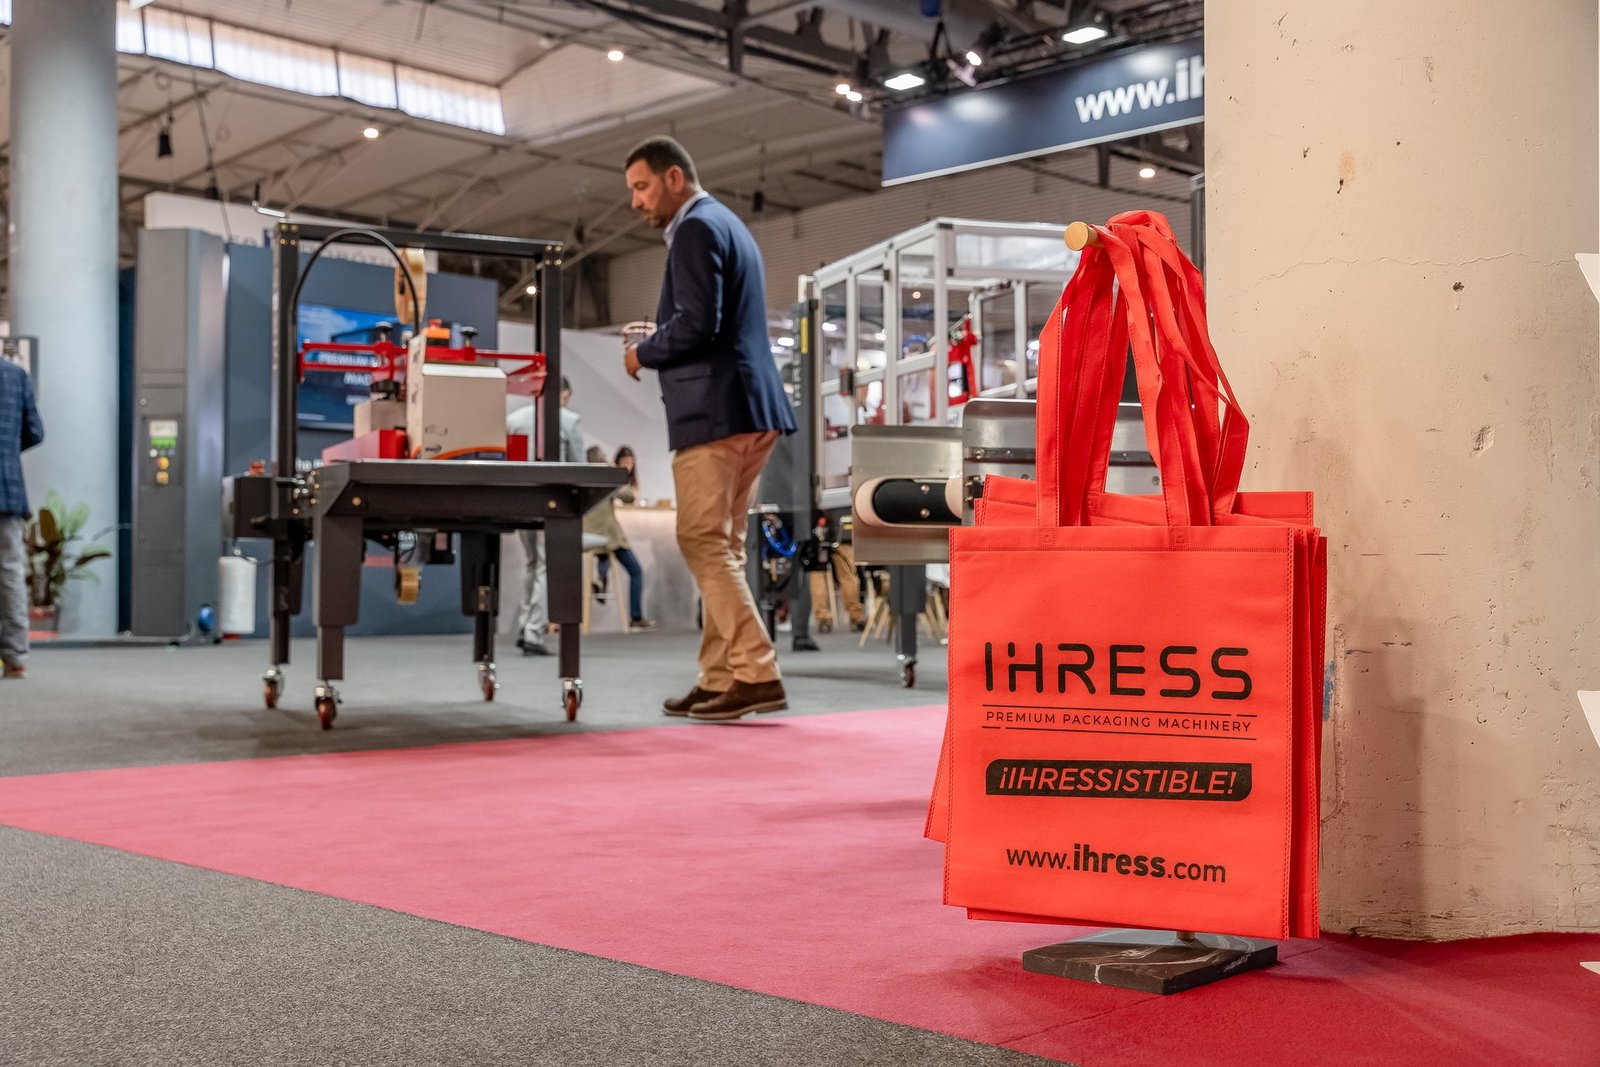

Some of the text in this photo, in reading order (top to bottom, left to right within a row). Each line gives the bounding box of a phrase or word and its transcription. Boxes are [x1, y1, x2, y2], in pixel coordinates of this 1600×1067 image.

[985, 641, 1253, 701] IHRESS
[986, 711, 1252, 733] PREMIUM PACKAGING MACHINERY
[999, 766, 1238, 795] ¡IHRESSISTIBLE!
[1006, 843, 1227, 884] www.ihress.com
